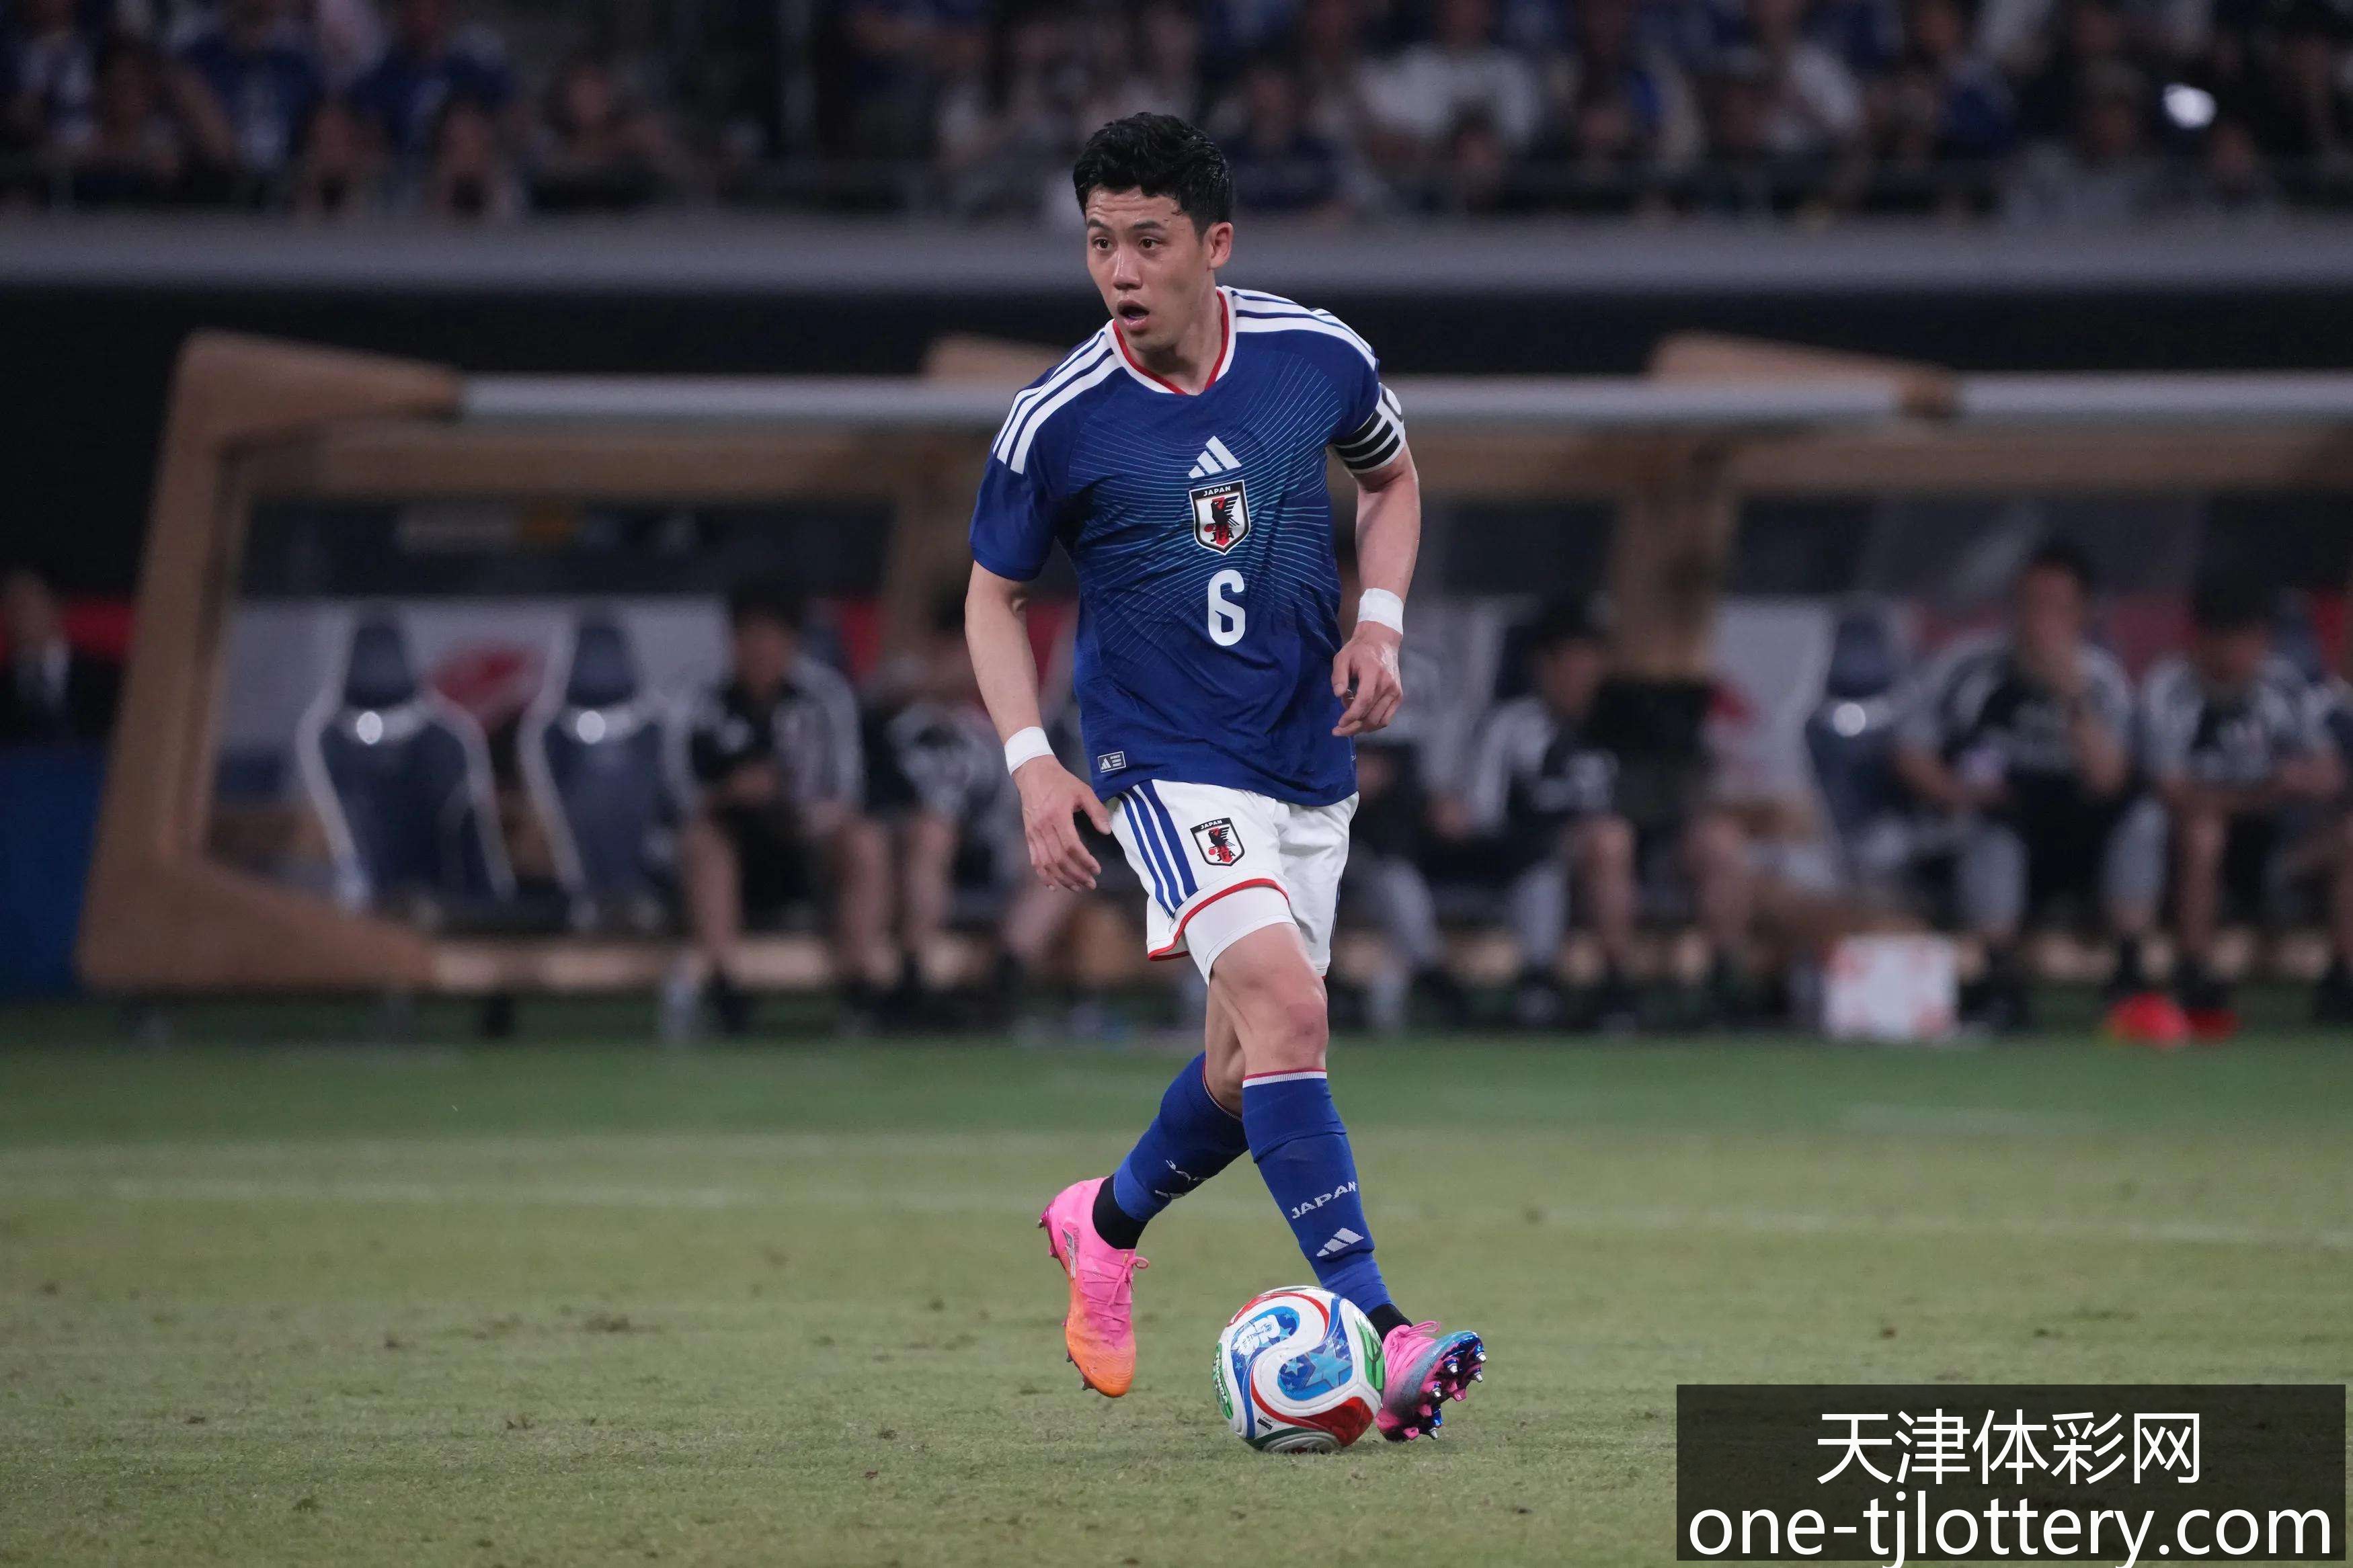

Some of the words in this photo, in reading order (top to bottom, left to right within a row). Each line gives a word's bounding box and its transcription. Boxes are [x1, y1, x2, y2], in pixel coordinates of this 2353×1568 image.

[1203, 486, 1231, 496] JAPAN
[1208, 569, 1245, 646] 6
[1201, 820, 1222, 829] JAPAN
[1291, 1181, 1357, 1219] JAPAN
